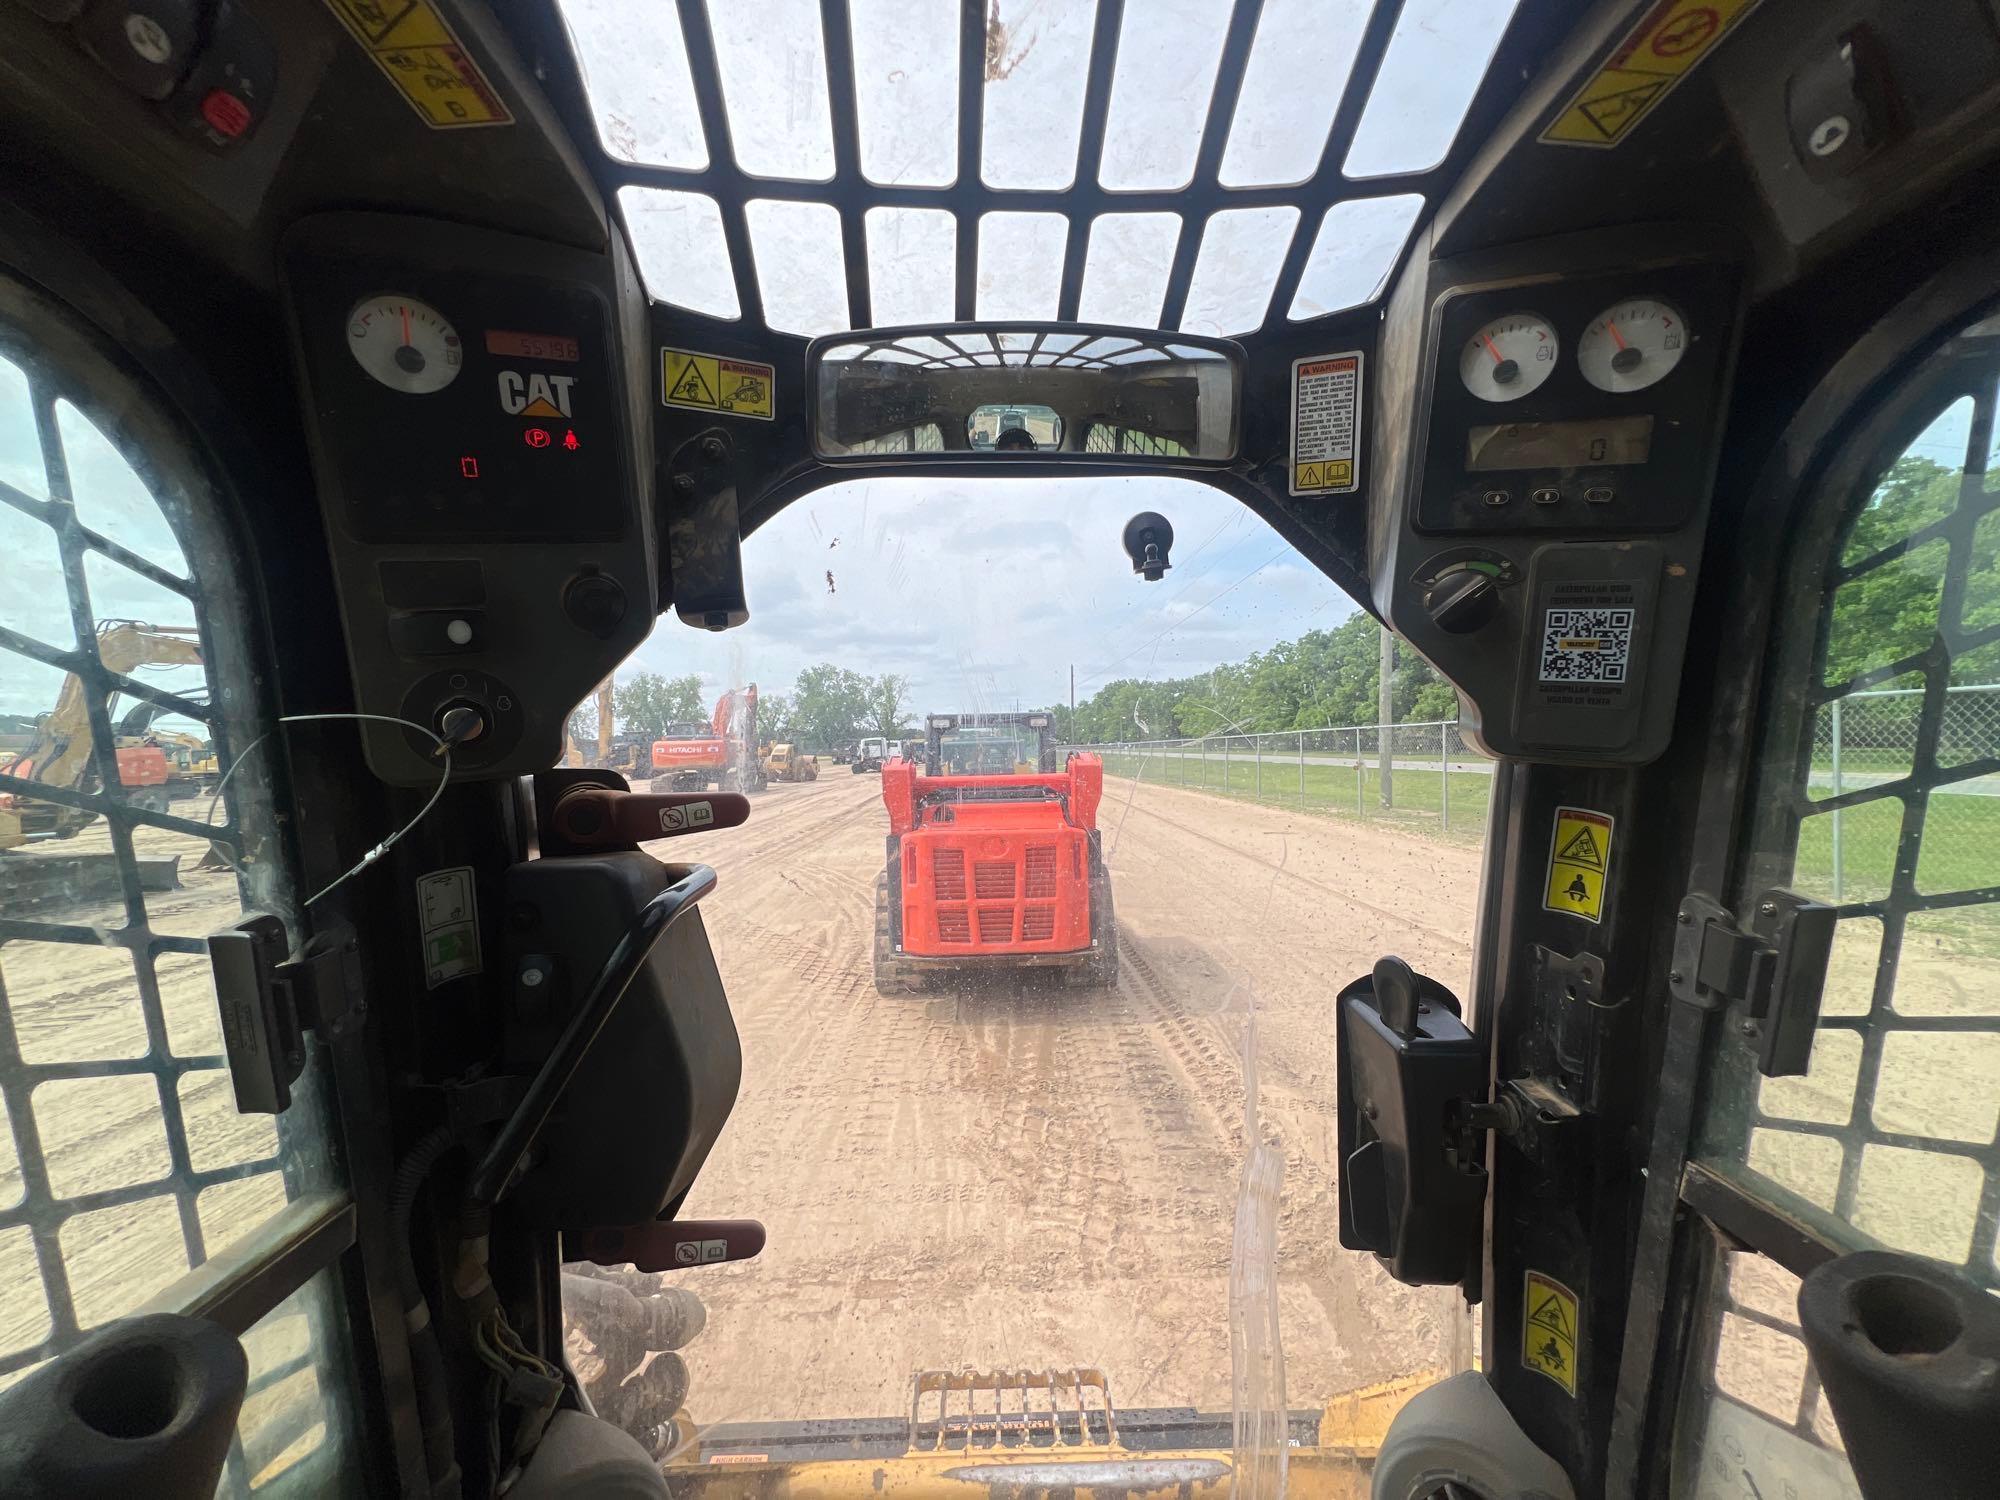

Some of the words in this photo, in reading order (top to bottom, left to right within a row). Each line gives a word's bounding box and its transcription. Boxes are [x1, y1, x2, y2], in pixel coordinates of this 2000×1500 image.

[732, 364, 770, 377] WARNING
[1312, 360, 1353, 374] WARNING
[498, 370, 574, 418] CAT
[669, 746, 702, 754] HITACHI
